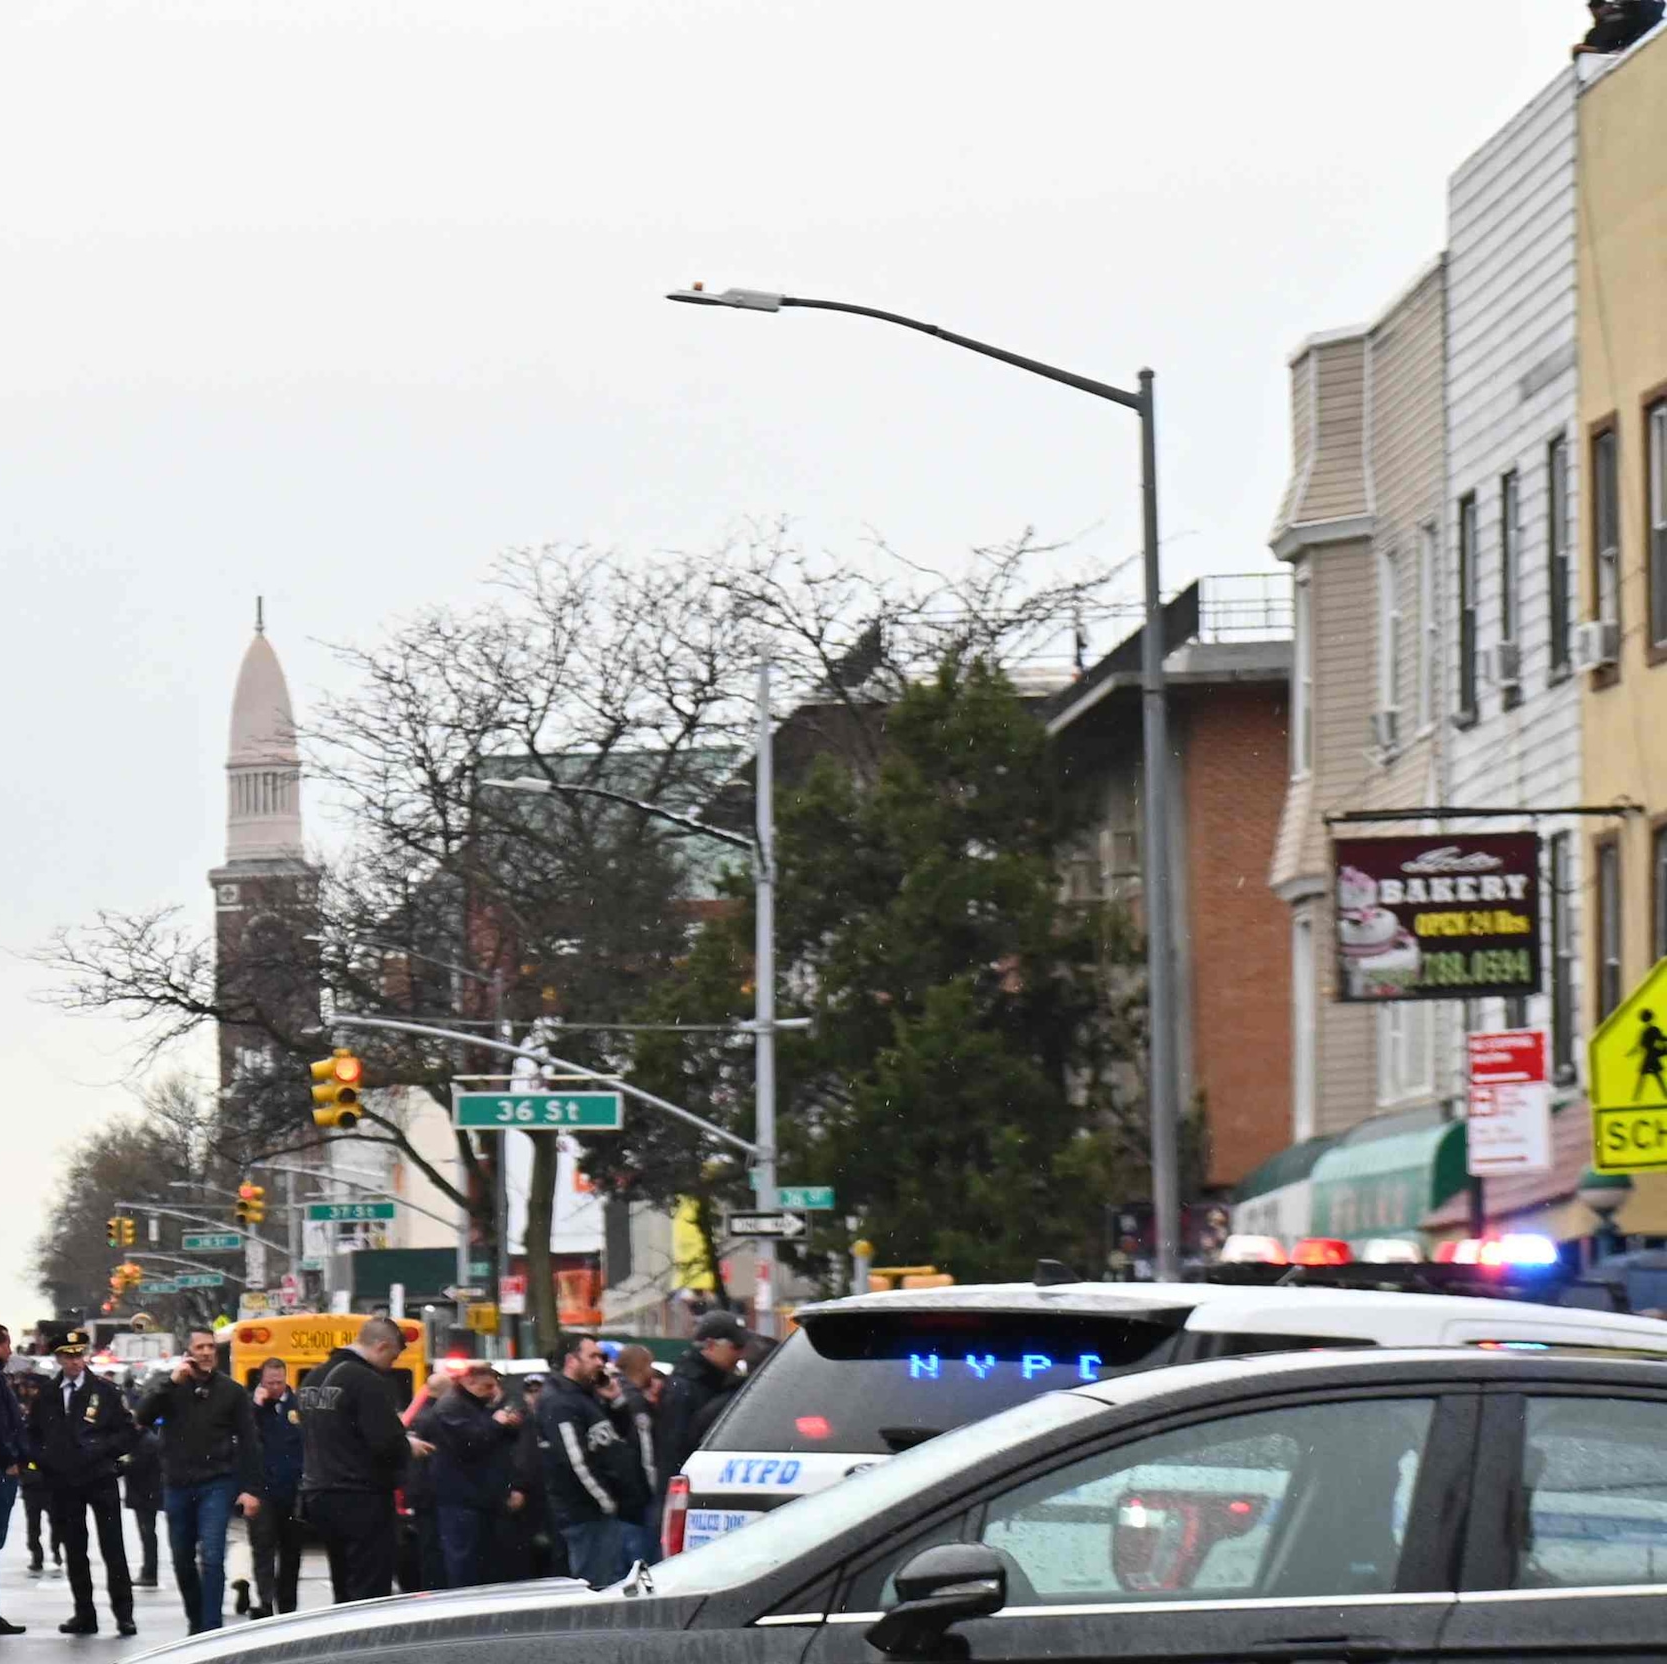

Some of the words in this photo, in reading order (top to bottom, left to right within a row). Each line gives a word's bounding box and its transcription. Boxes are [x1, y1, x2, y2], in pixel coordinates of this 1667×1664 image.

[1378, 874, 1529, 904] BAKERY
[496, 1101, 534, 1121] 36
[544, 1100, 579, 1122] St
[1607, 1120, 1667, 1150] SCH
[291, 1330, 334, 1348] SCHOOL
[718, 1459, 801, 1485] NYPD
